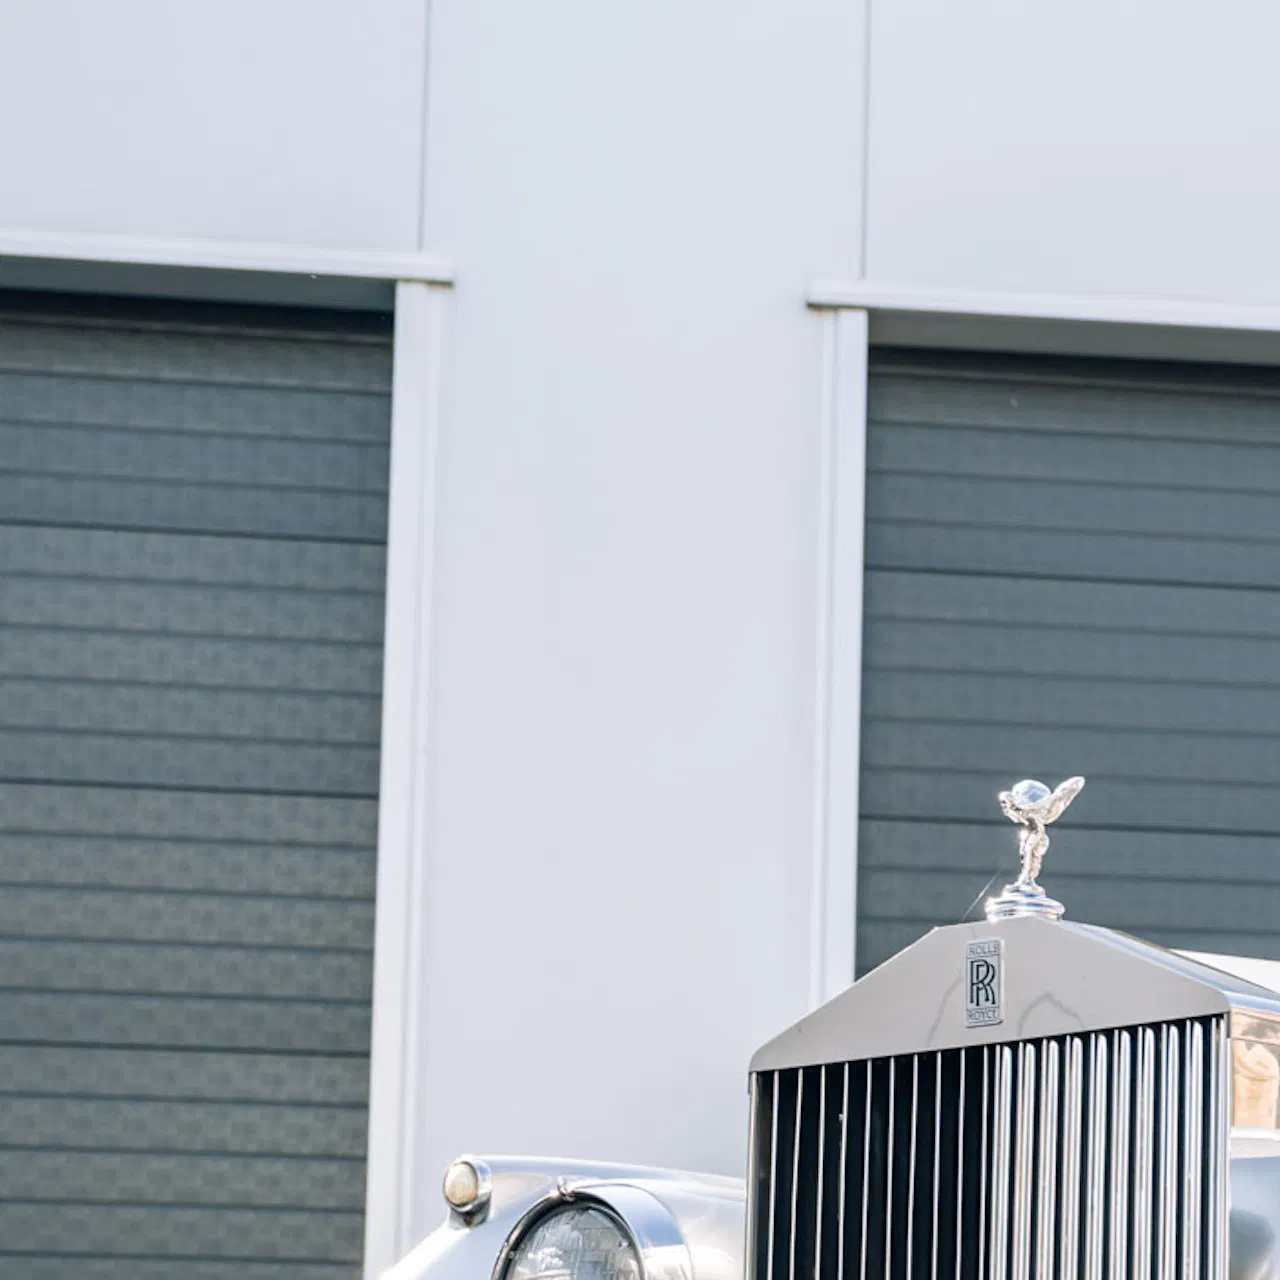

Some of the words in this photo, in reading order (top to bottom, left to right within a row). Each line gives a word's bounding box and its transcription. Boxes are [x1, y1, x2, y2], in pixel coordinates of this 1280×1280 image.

[969, 944, 997, 956] ROLLS
[970, 959, 996, 1006] RR
[968, 1009, 996, 1021] ROYCE
